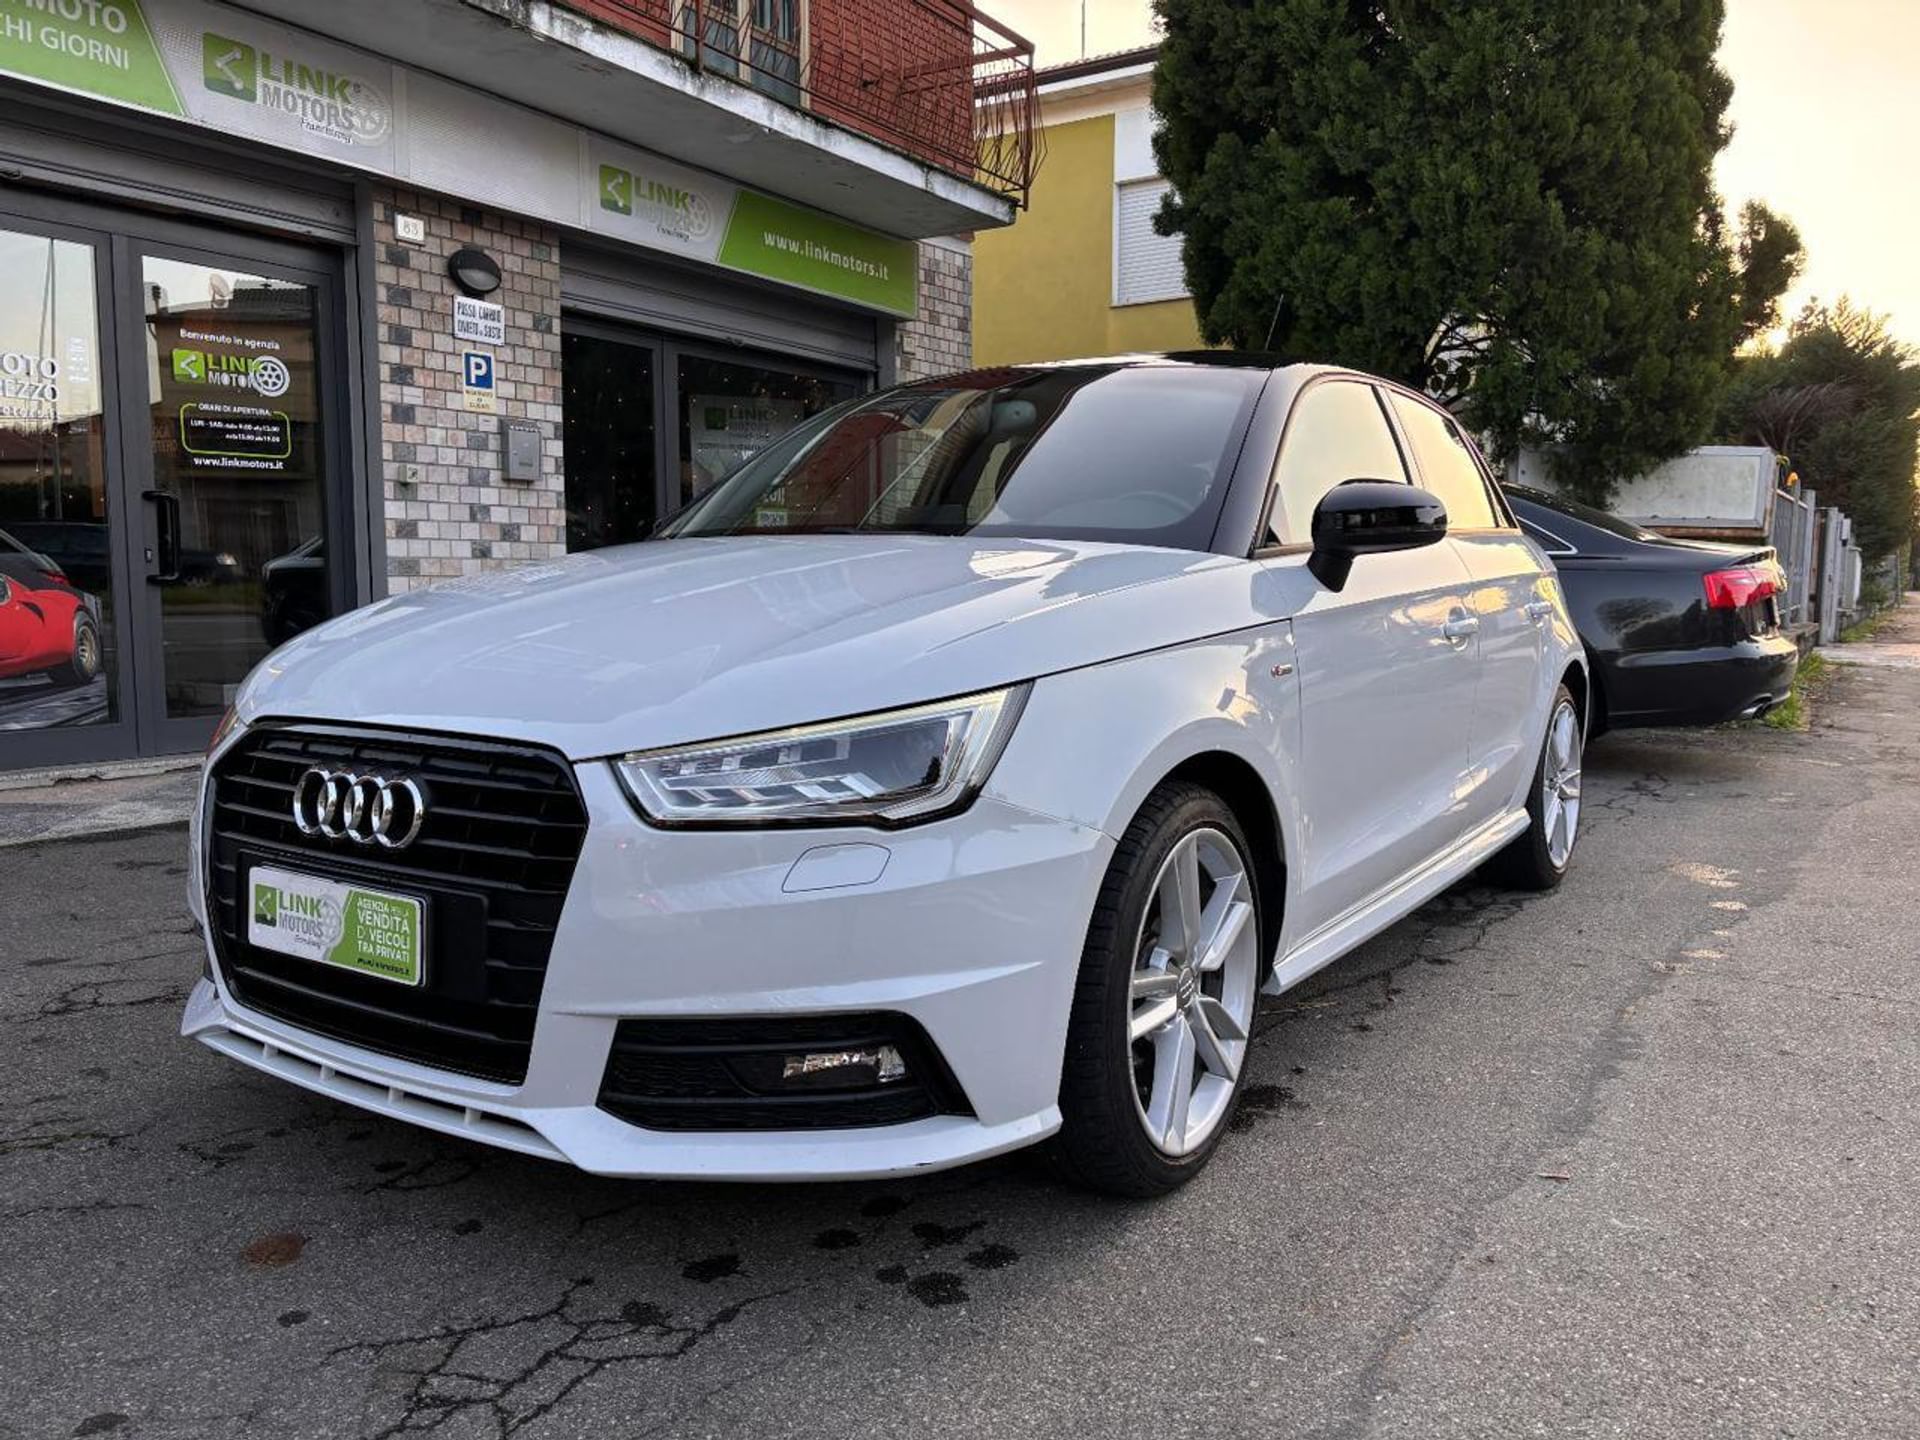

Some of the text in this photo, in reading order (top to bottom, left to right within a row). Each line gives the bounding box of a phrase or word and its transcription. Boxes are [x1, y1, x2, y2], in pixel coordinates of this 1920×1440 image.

[40, 26, 129, 70] GIORNI
[260, 52, 352, 104] LINK
[261, 82, 355, 131] MOTORS
[634, 175, 690, 213] LINK
[763, 231, 889, 280] www.linkmotors.it
[208, 370, 258, 390] MOTOR
[469, 355, 489, 385] P
[0, 377, 61, 402] EZZO
[193, 456, 285, 471] www.linkmotors.it
[279, 890, 322, 919] LINK
[357, 907, 410, 935] VENDITA
